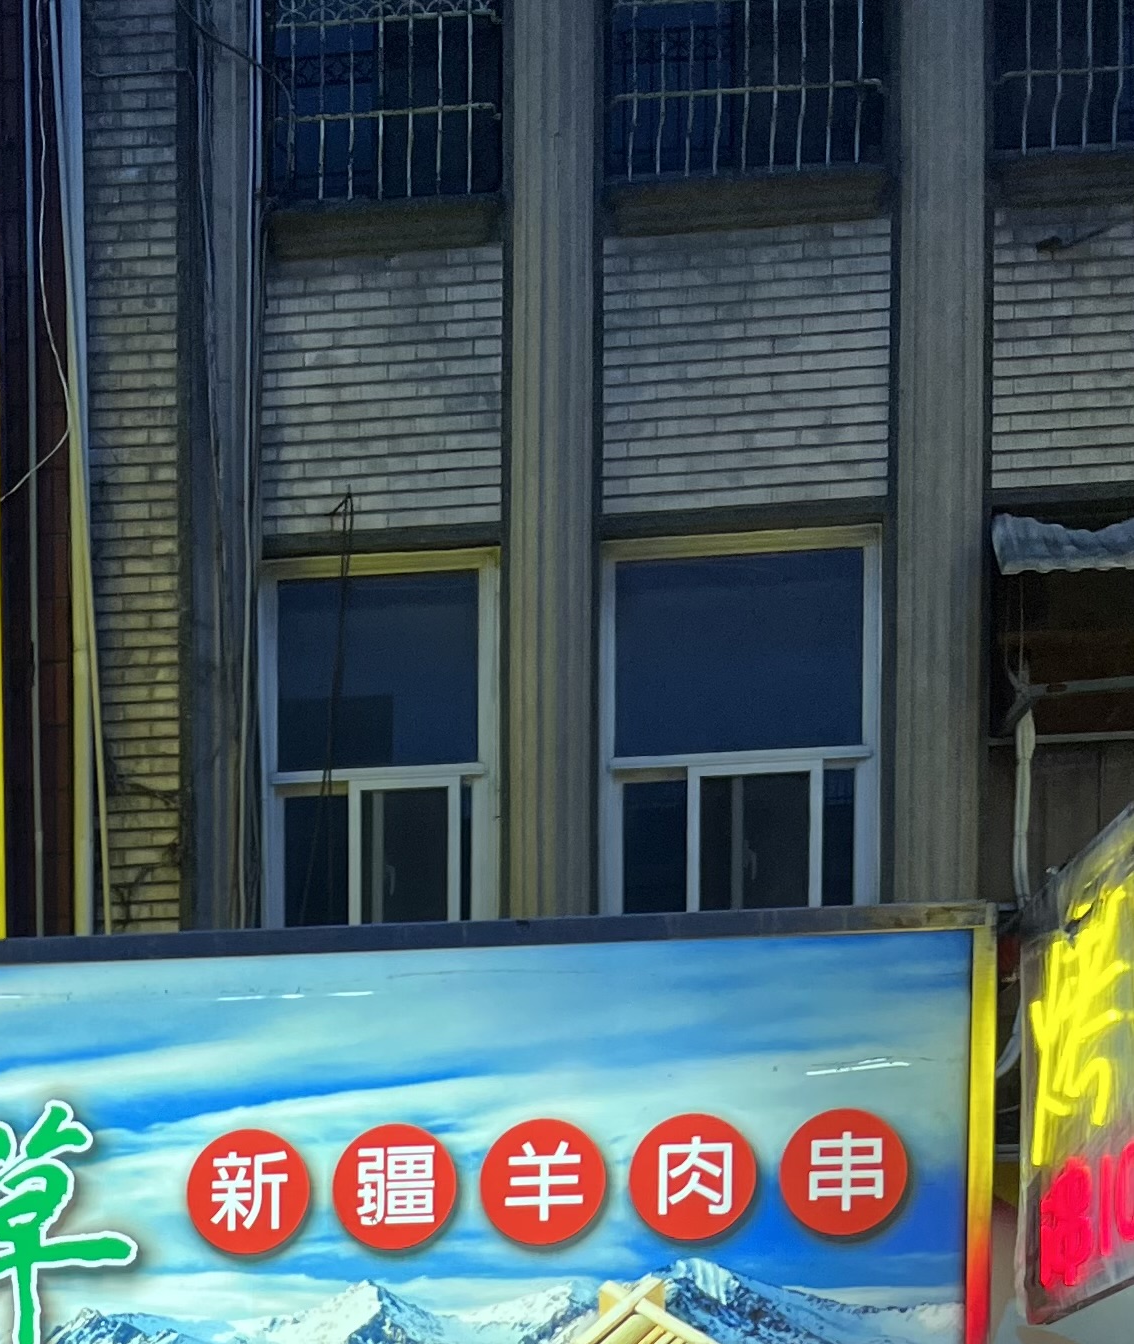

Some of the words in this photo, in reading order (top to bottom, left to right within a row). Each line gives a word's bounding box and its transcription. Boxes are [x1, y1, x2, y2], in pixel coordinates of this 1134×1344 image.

[210, 1130, 885, 1233] 新疆羊肉串
